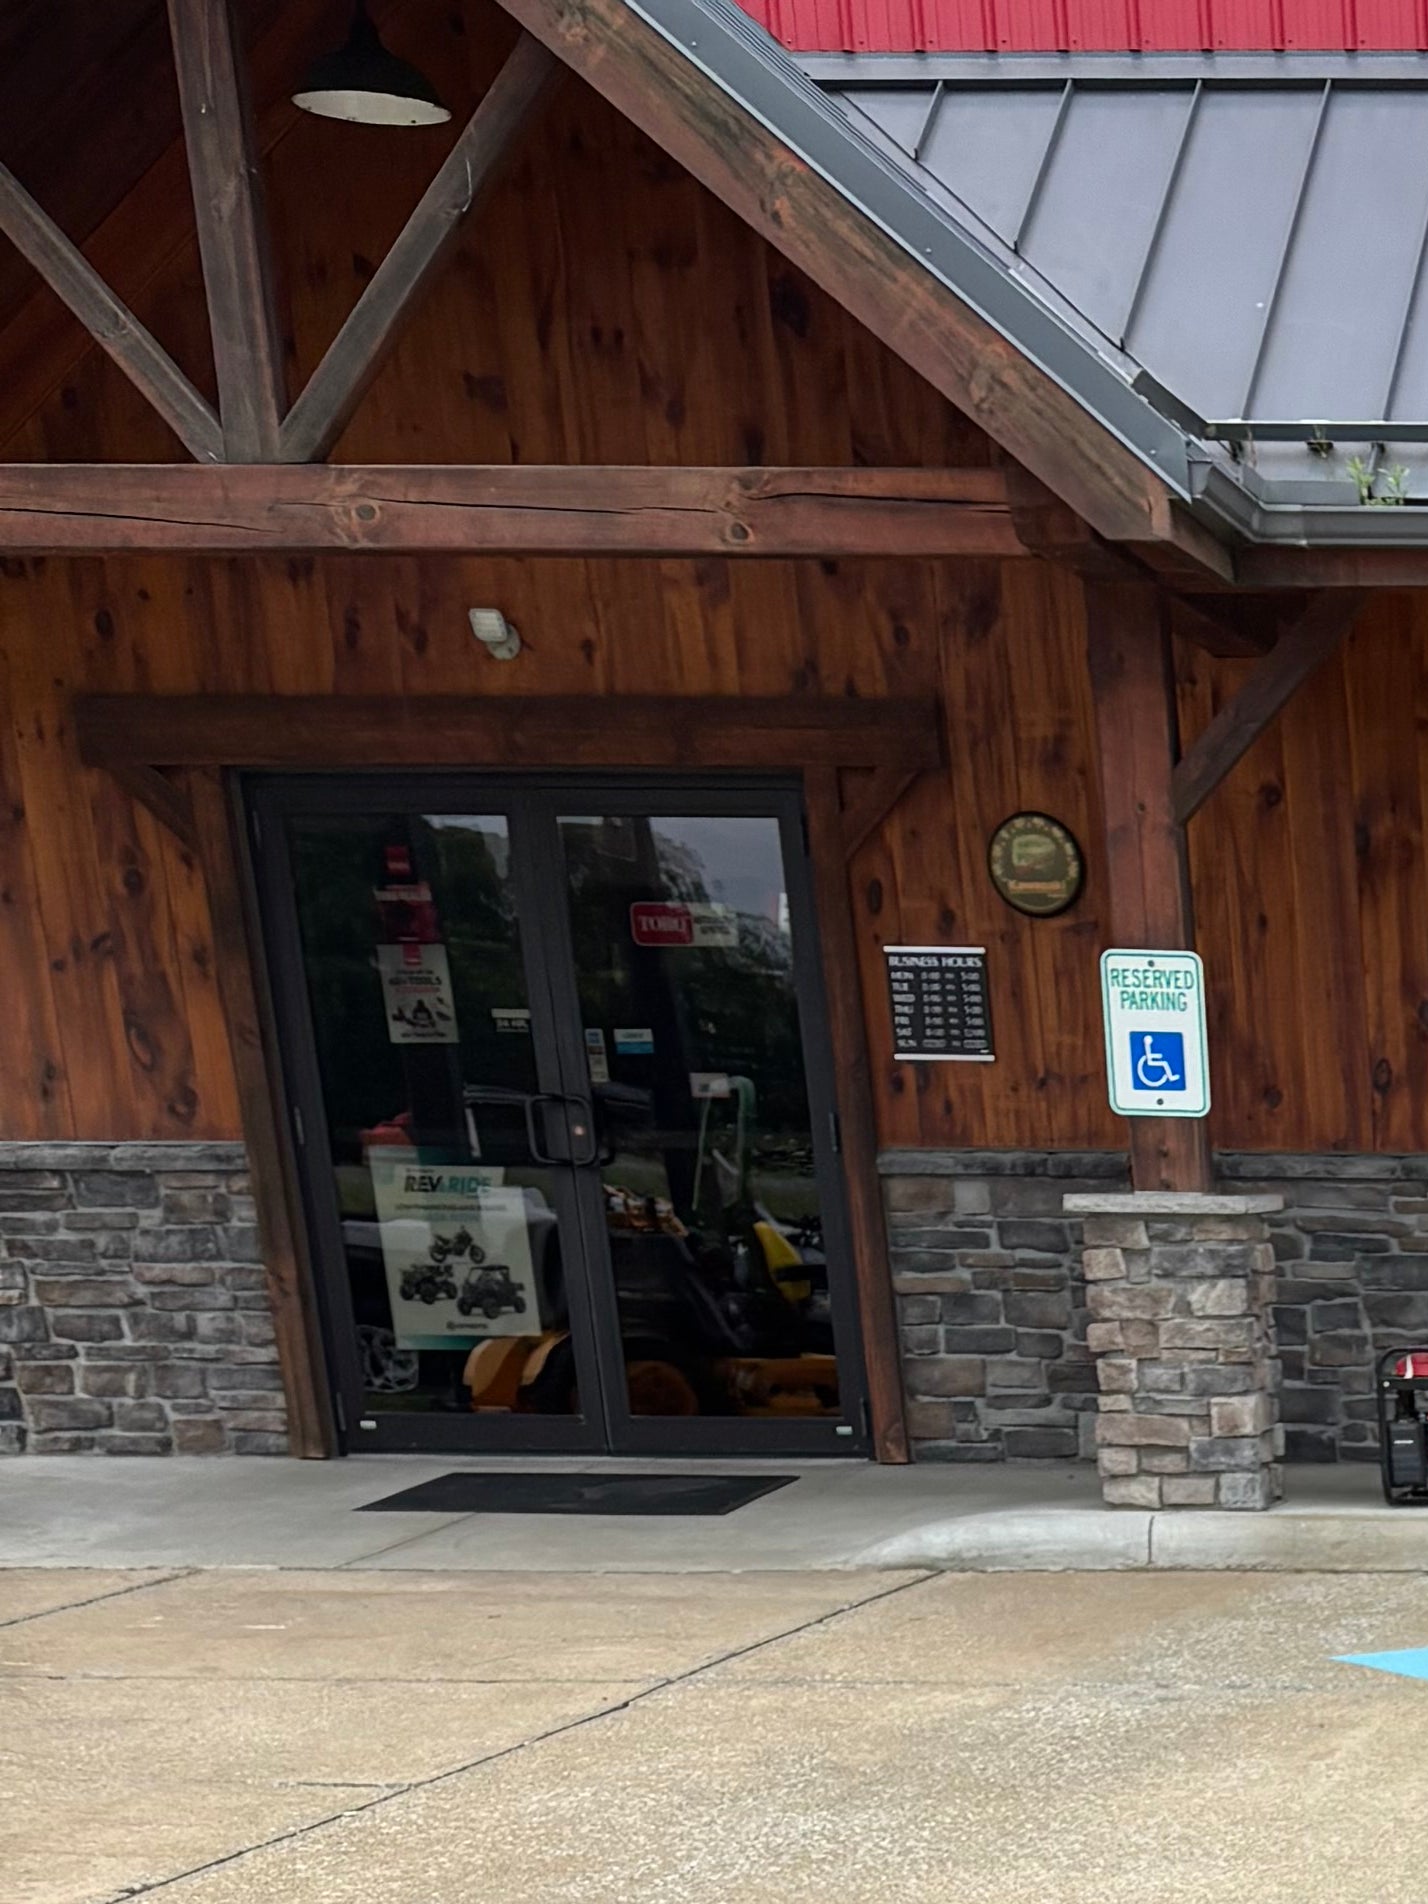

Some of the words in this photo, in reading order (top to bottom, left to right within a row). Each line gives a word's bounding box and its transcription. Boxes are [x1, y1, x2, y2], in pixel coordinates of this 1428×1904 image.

[941, 957, 982, 967] HOURS
[1110, 968, 1195, 990] RESERVED
[1120, 990, 1188, 1012] PARKING
[404, 1175, 443, 1193] REV
